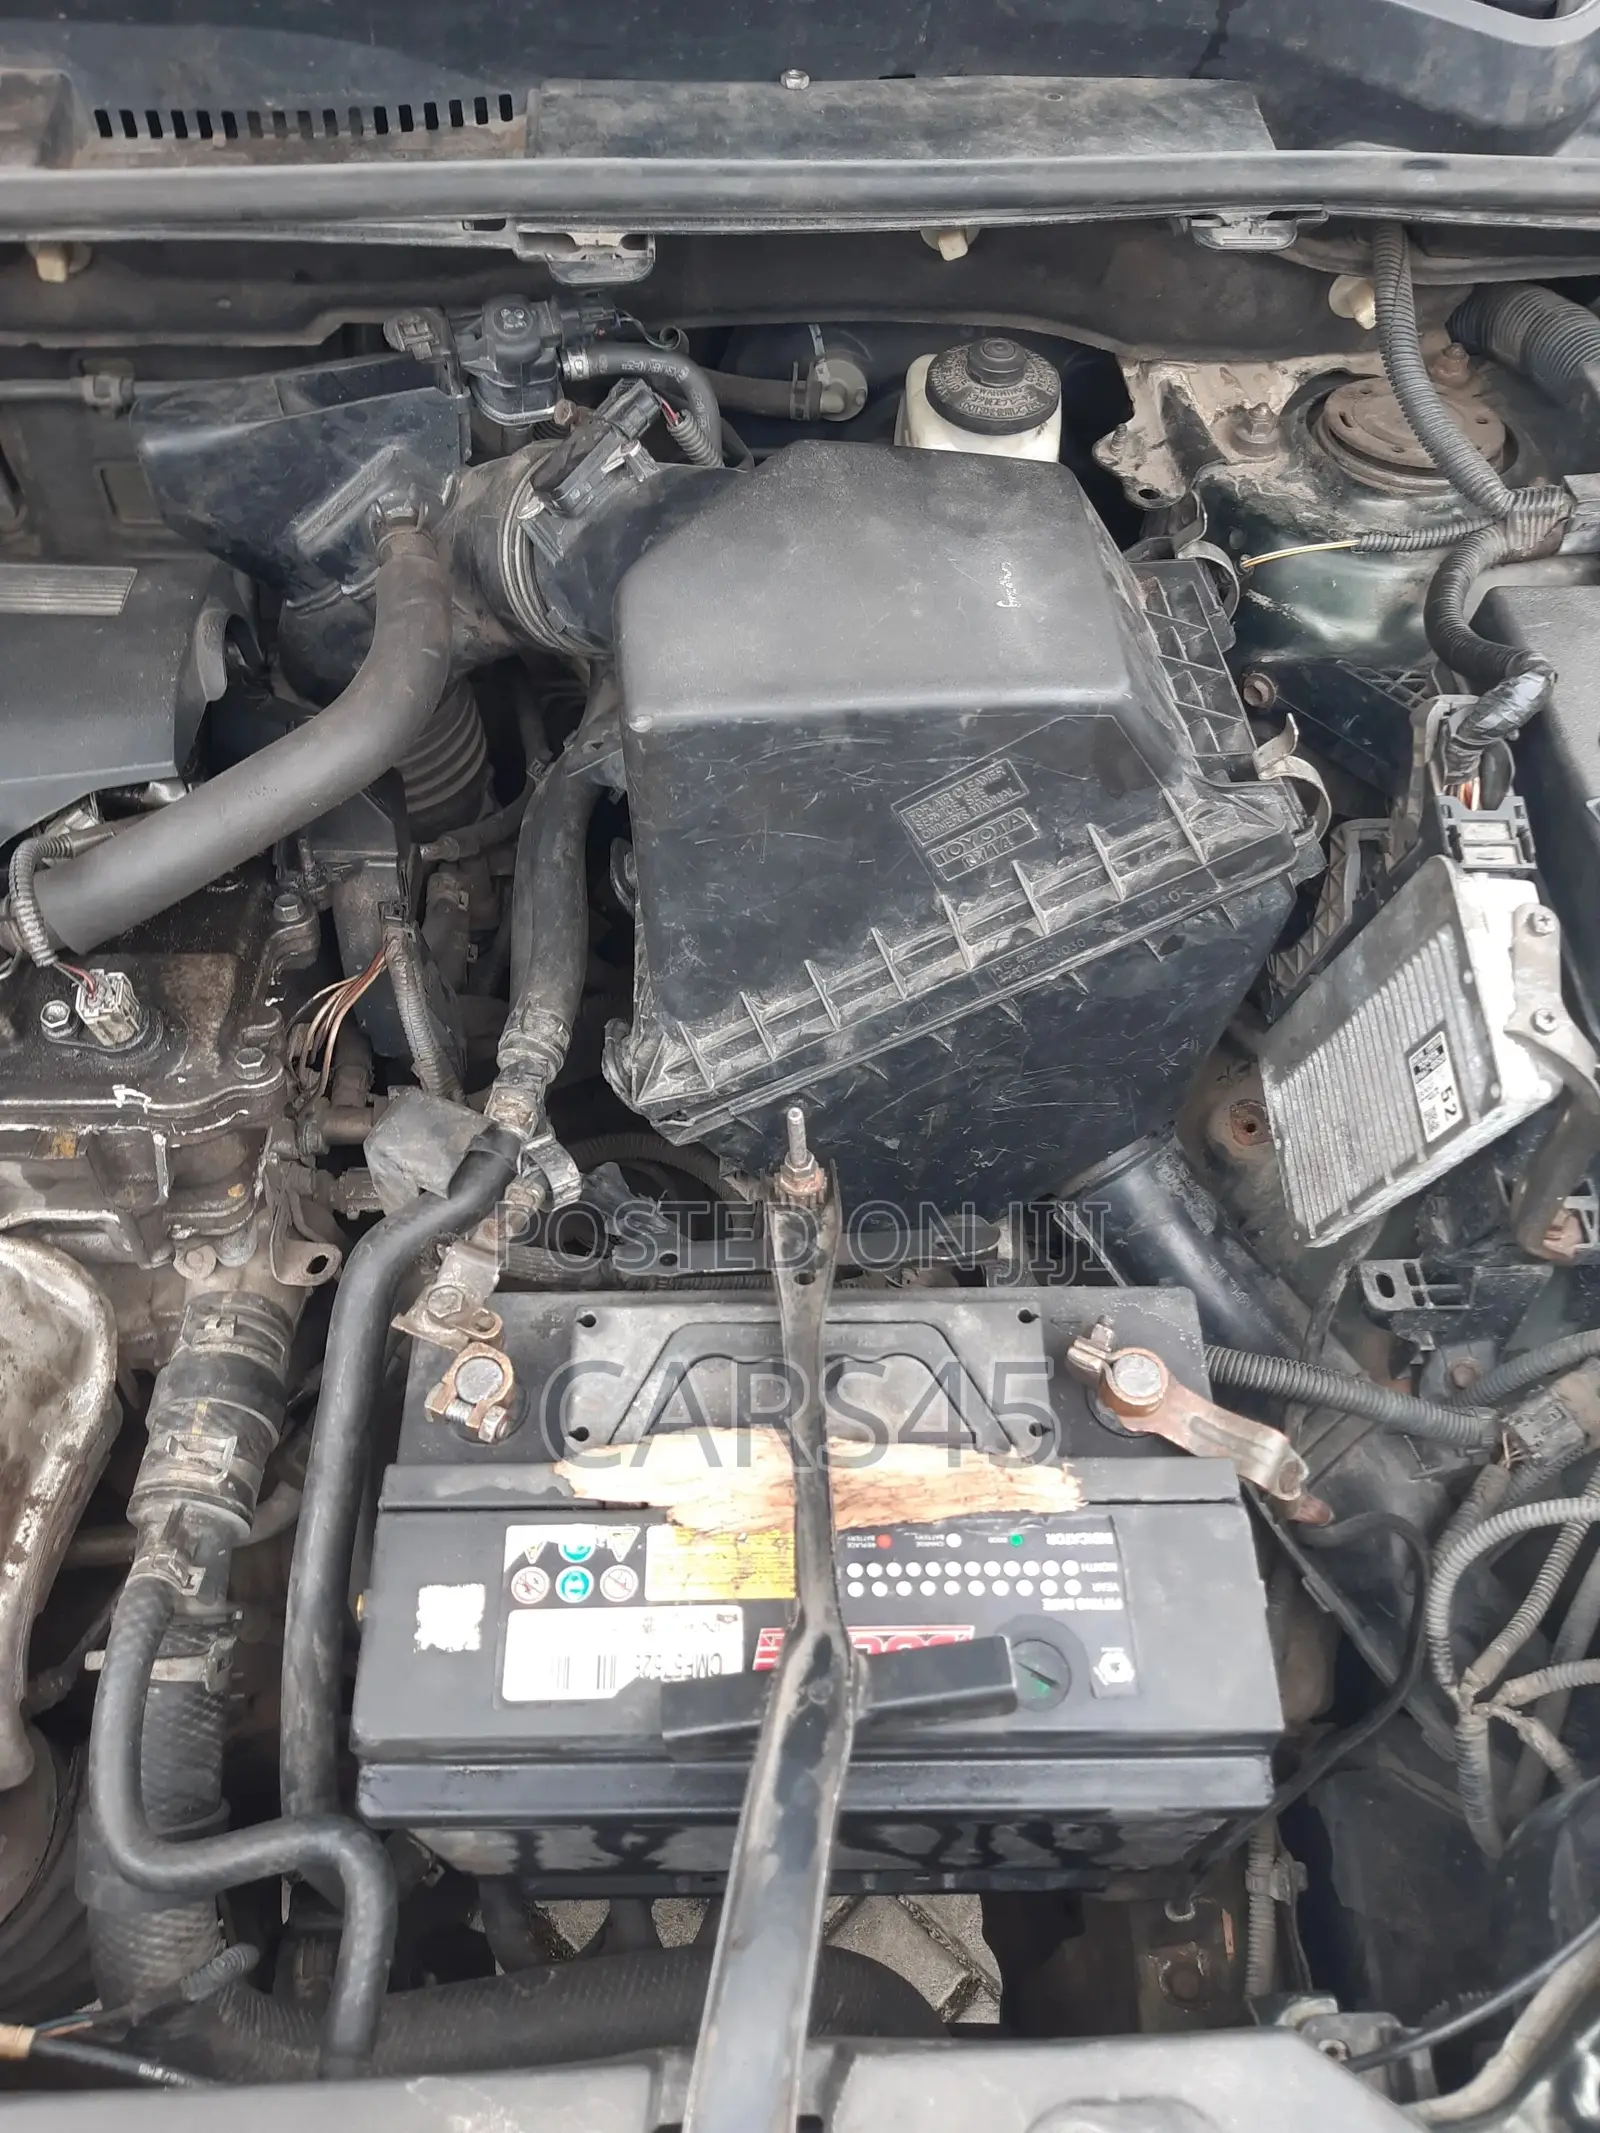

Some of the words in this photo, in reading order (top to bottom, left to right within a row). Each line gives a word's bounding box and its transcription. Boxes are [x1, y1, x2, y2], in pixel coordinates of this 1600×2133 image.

[952, 766, 1006, 799] CLEANER
[968, 787, 1022, 816] MANUAL
[930, 811, 1028, 865] TOYOTA
[1045, 1532, 1114, 1546] INDICATOR
[1080, 1562, 1118, 1573] MONTH
[1090, 1581, 1120, 1593] YEAR
